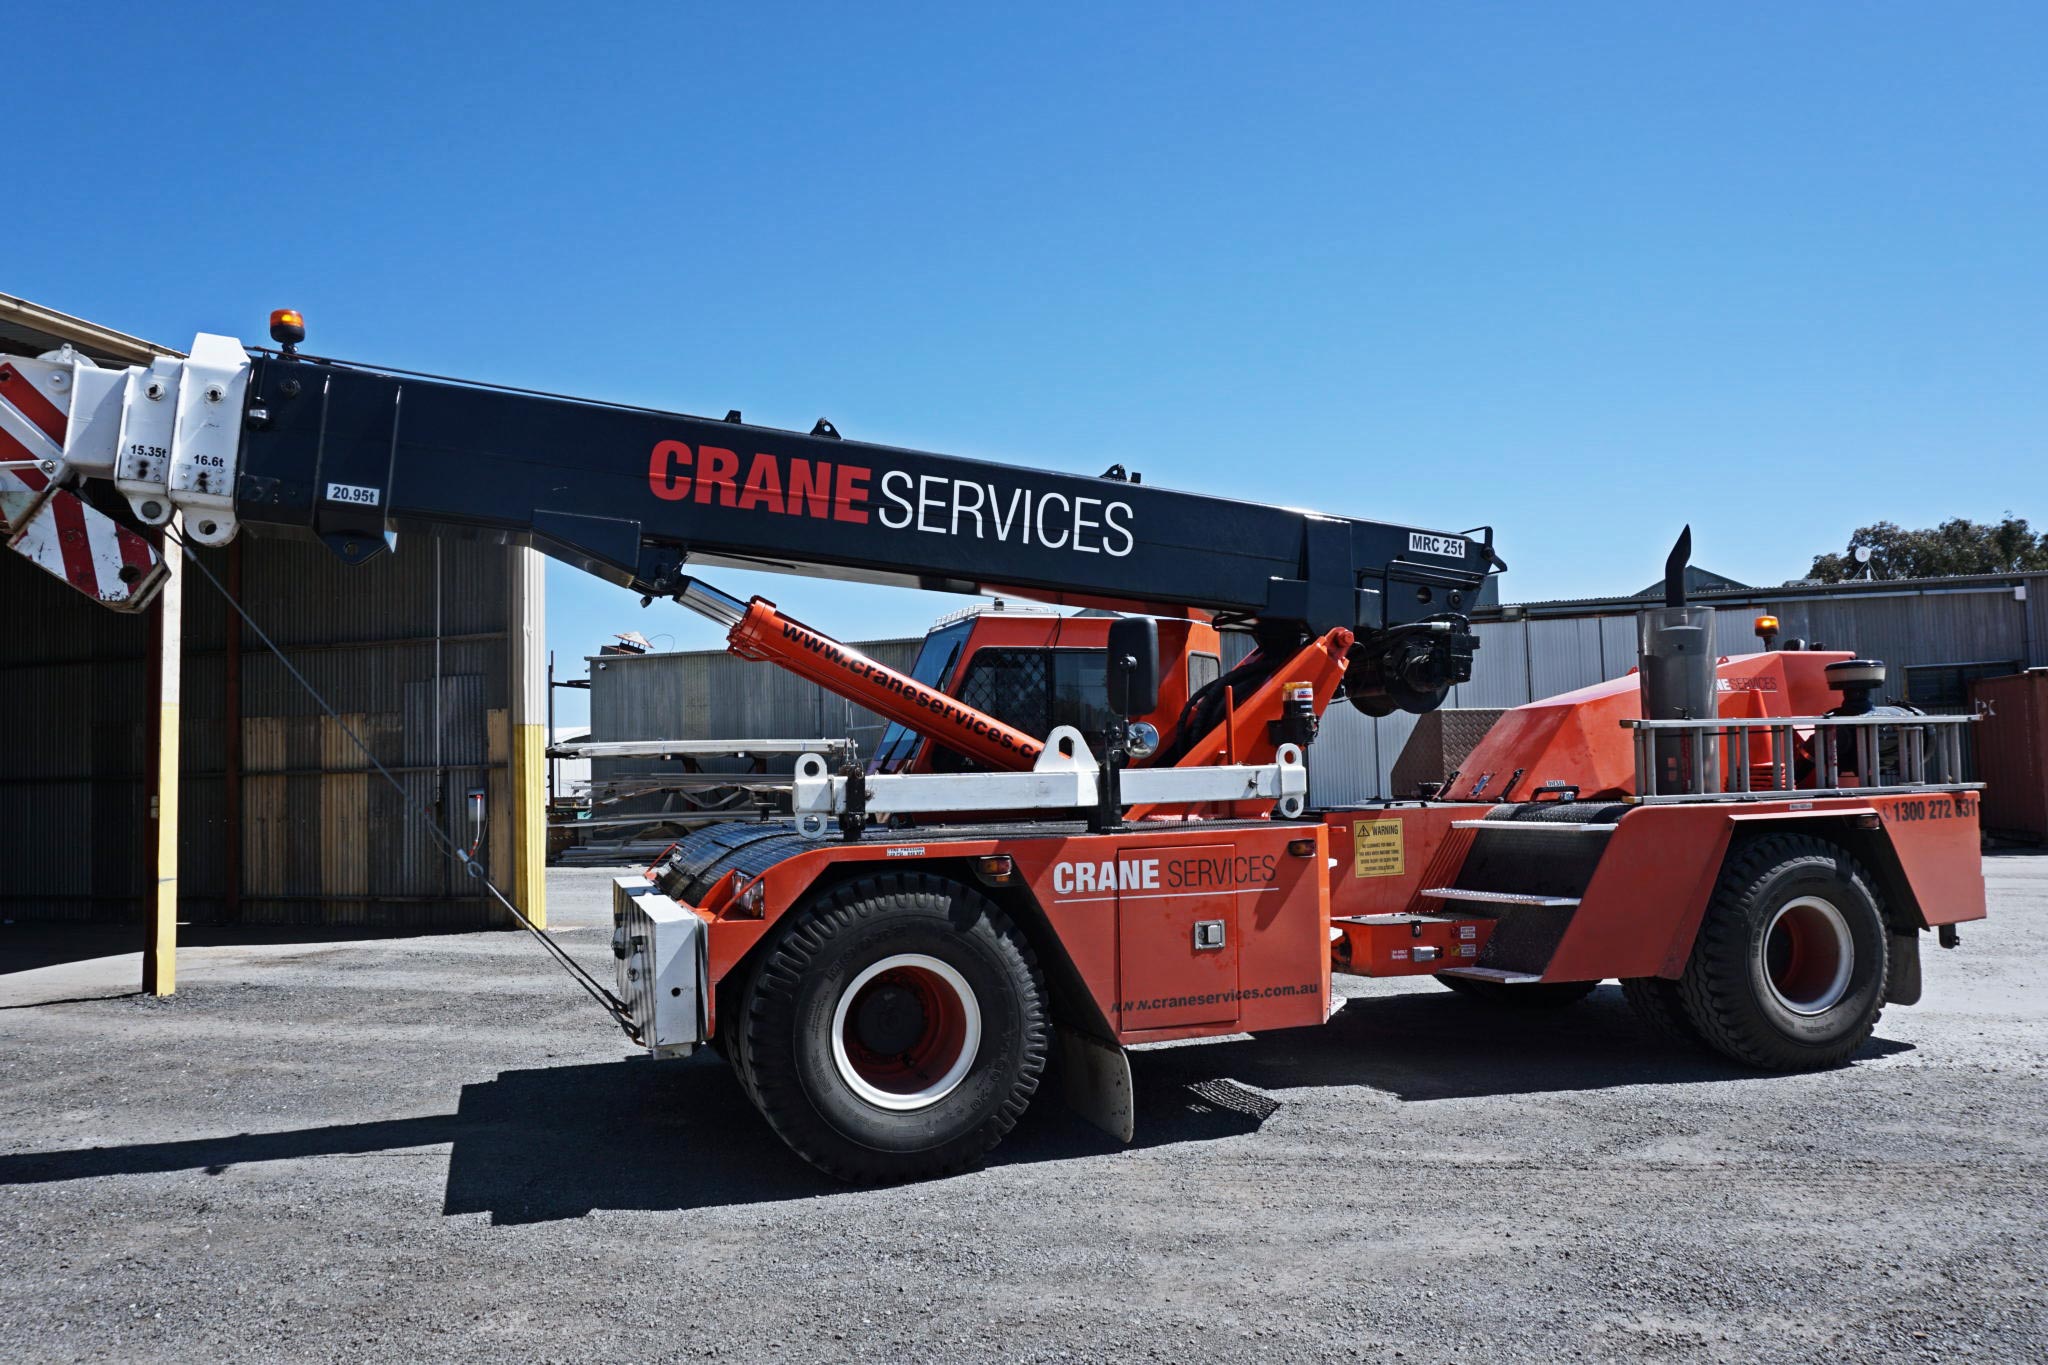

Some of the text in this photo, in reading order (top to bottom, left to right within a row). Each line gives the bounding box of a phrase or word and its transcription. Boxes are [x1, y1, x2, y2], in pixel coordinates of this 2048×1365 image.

[131, 444, 167, 458] 15.35t
[194, 454, 224, 467] 16.6t
[332, 486, 375, 503] 20.95t
[648, 439, 1134, 557] CRANE SERVICES
[1412, 535, 1463, 556] MRC 25t
[1729, 676, 1777, 690] SERVICES
[1893, 801, 1925, 822] 1300
[1928, 799, 1952, 820] 272
[1372, 824, 1399, 836] WARNING
[1053, 855, 1276, 895] CRANE SERVICES
